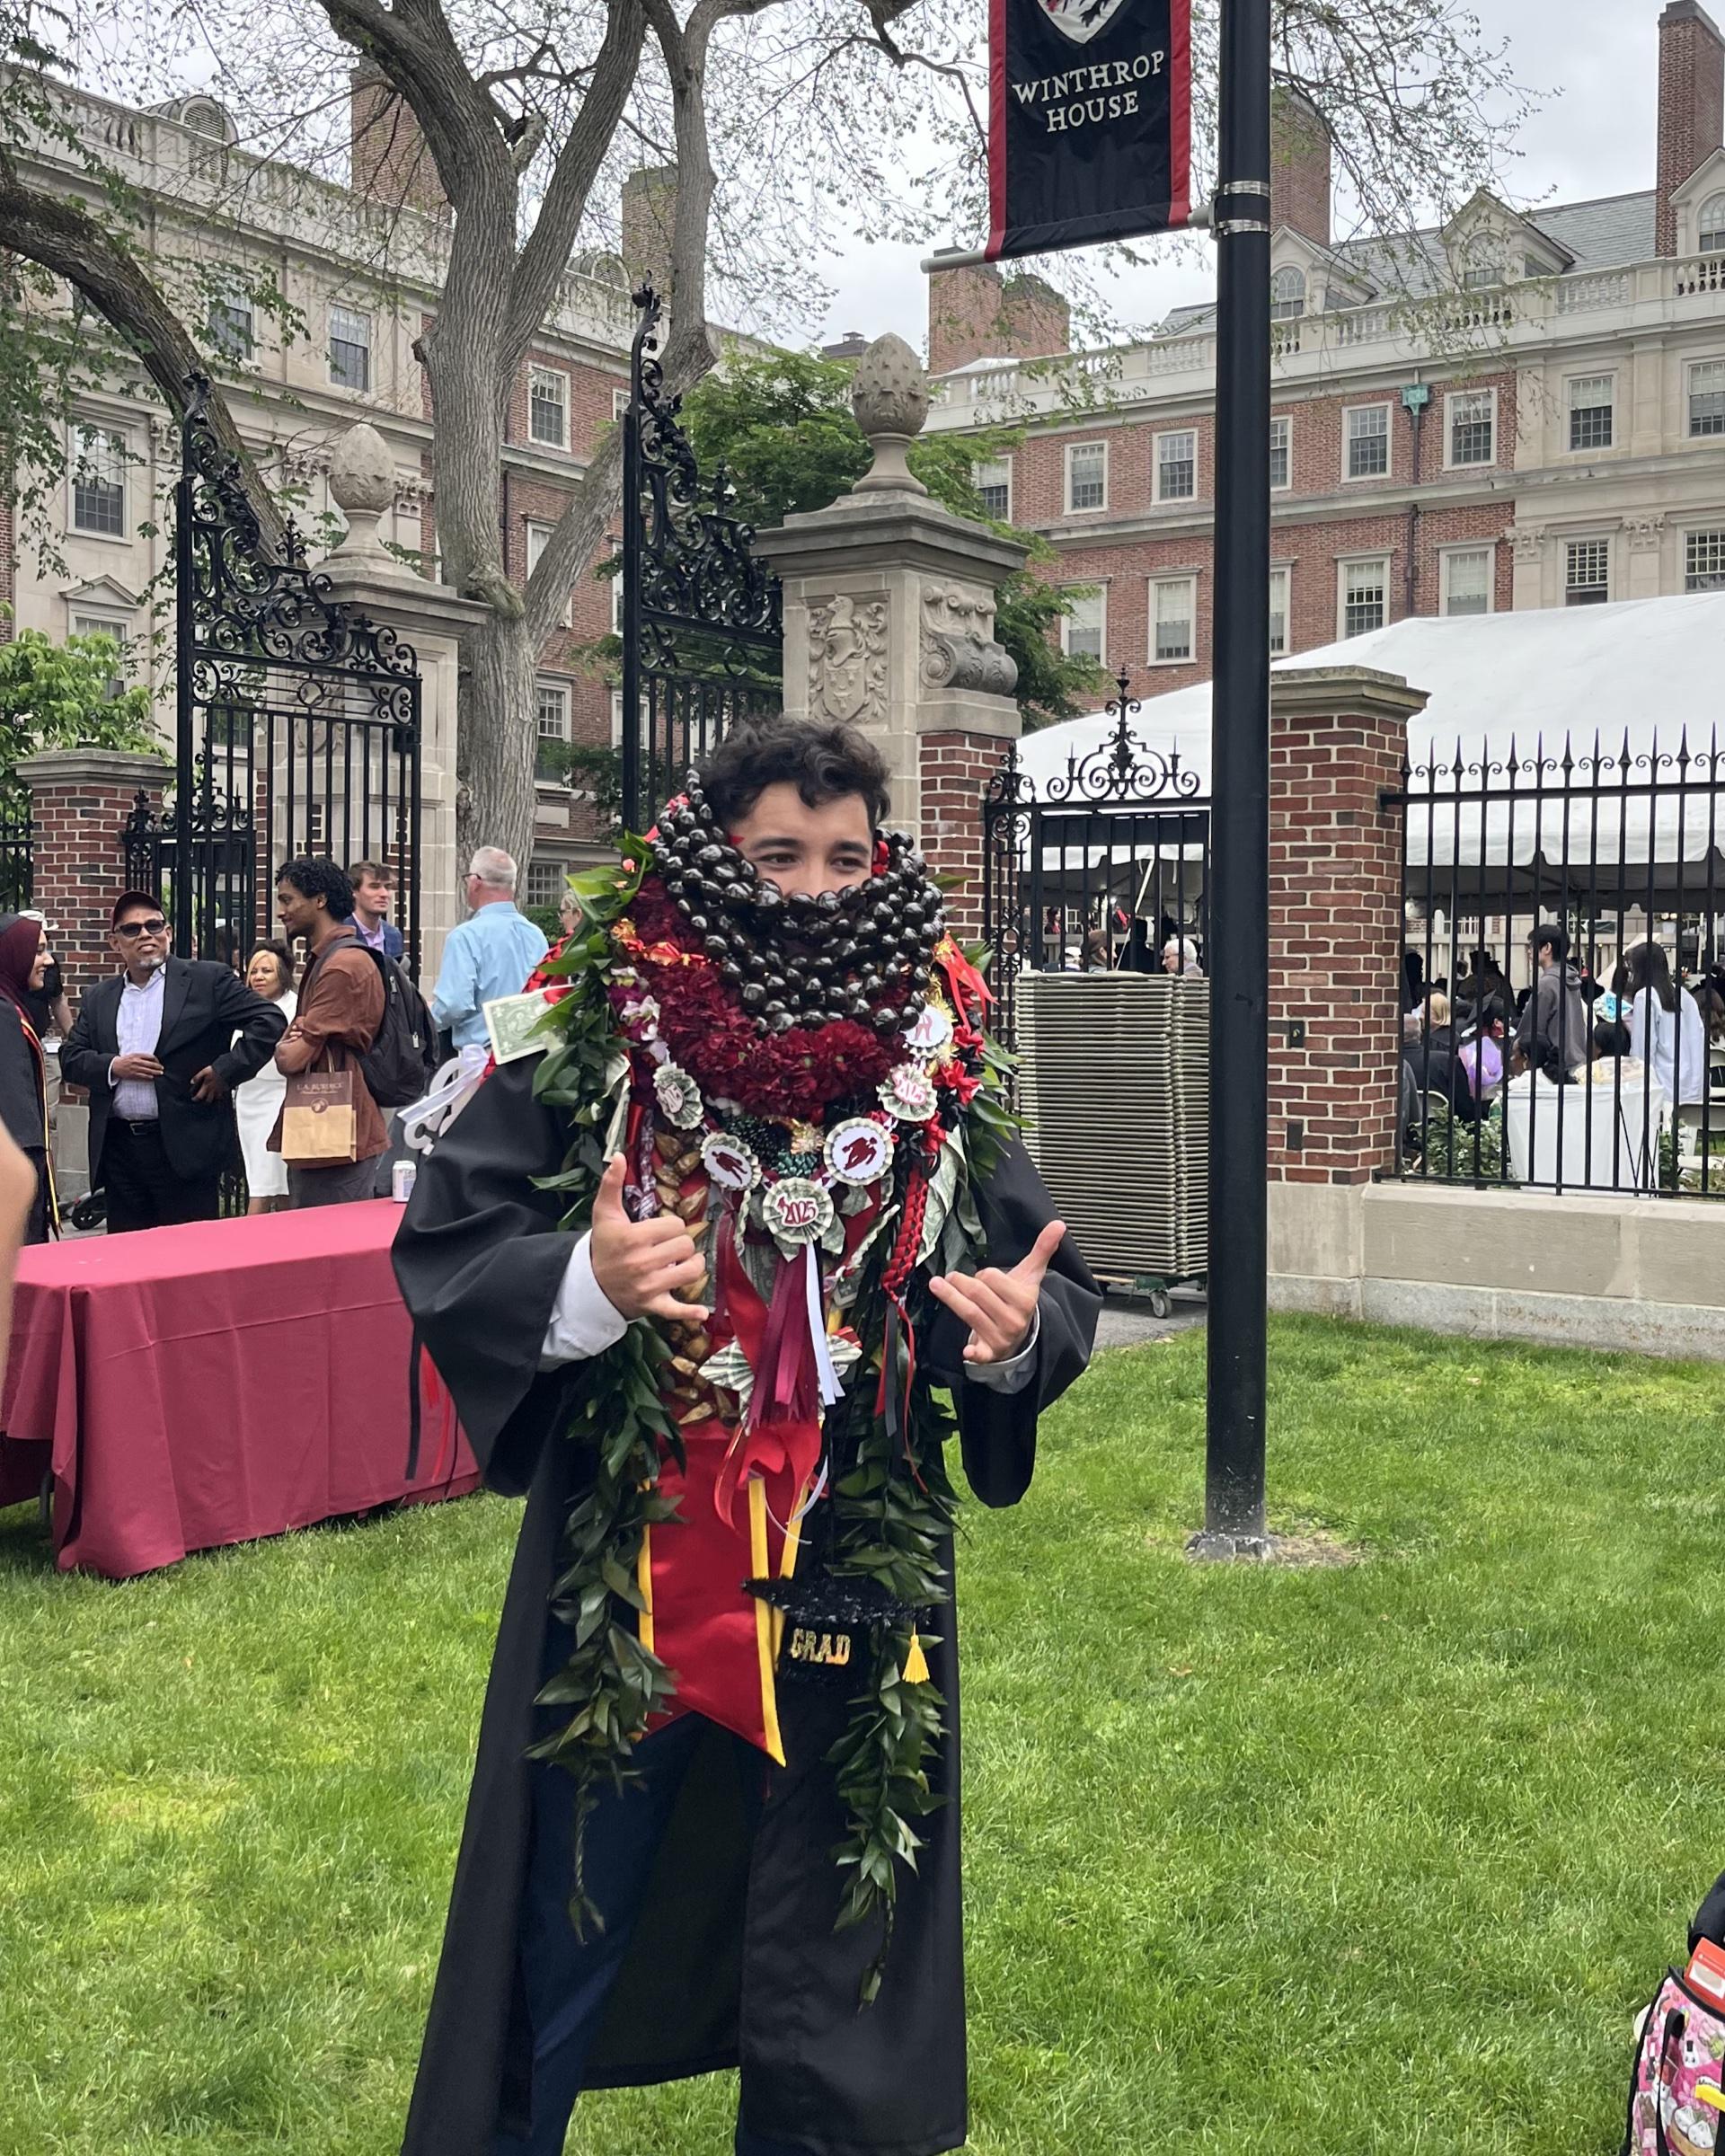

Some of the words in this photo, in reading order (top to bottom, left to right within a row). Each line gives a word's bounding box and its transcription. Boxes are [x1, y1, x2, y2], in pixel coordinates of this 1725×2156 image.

[1012, 50, 1164, 105] WINTHROP
[1047, 91, 1139, 133] HOUSE
[783, 1200, 816, 1224] 2025
[790, 1627, 852, 1666] GRAD
